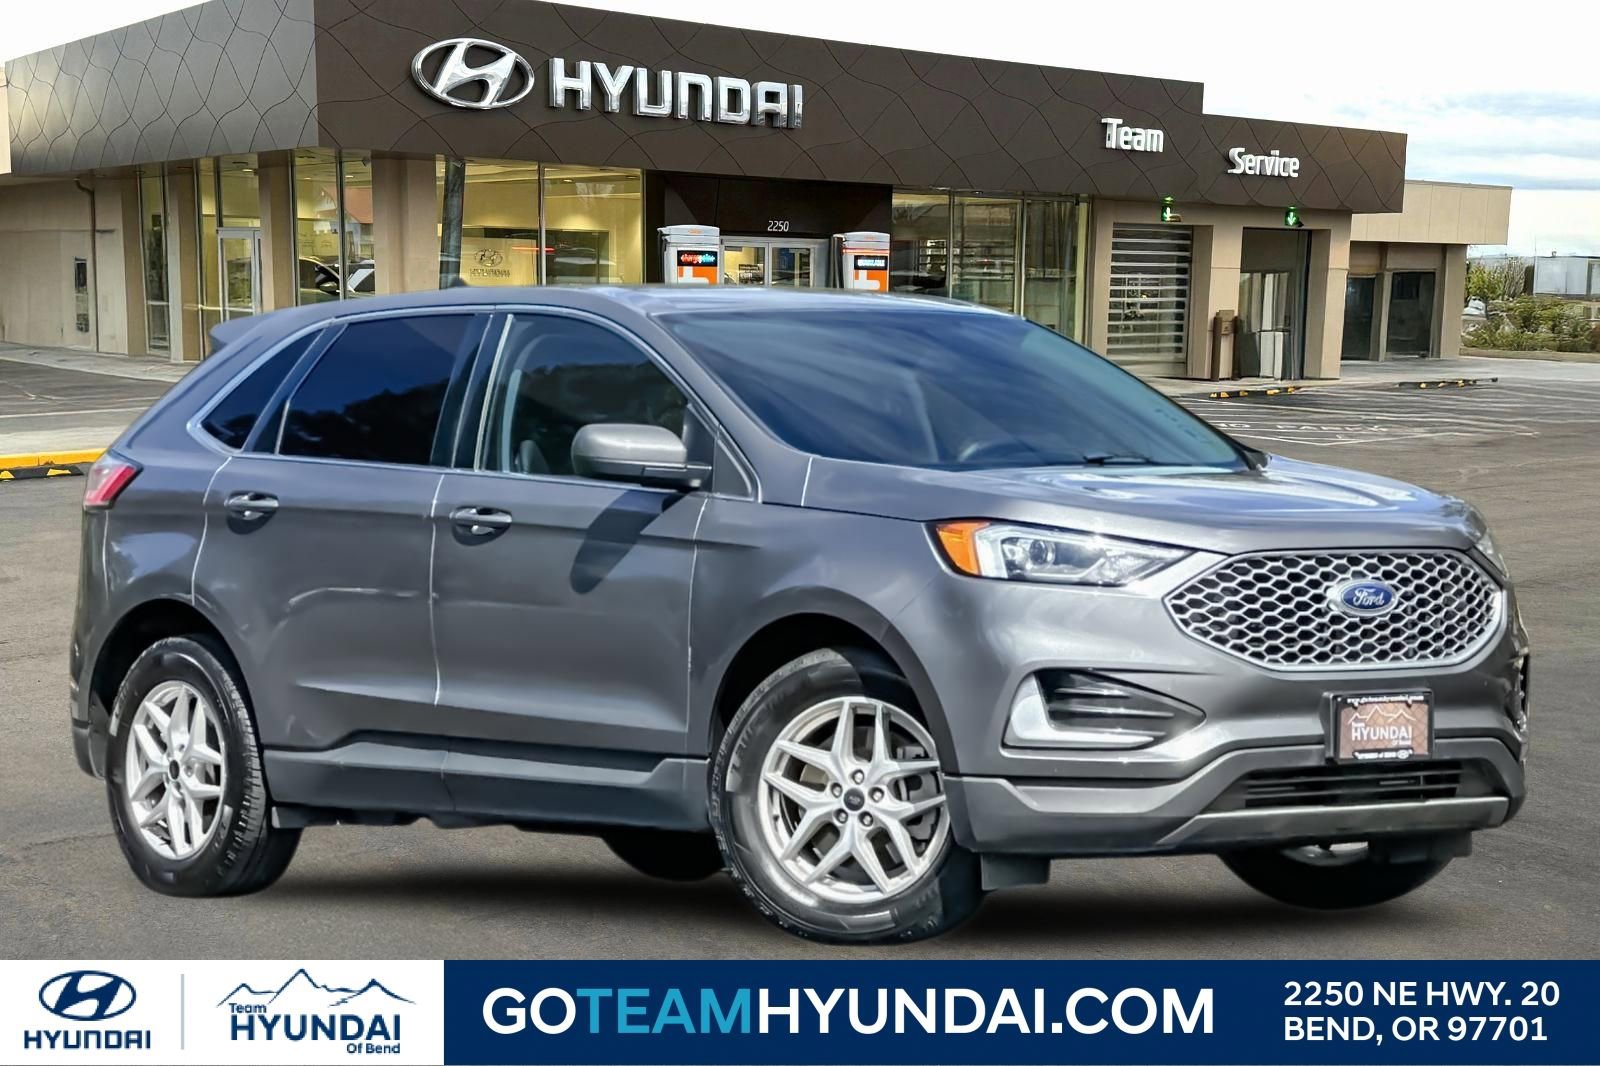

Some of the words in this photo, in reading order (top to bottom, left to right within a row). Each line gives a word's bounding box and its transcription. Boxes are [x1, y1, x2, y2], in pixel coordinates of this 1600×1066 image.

[549, 57, 804, 129] HYUNDAI
[1102, 117, 1164, 153] Team
[1227, 147, 1300, 178] Service
[767, 220, 790, 232] 2250
[1352, 587, 1385, 606] Ford
[1352, 724, 1412, 741] HYUNDAI
